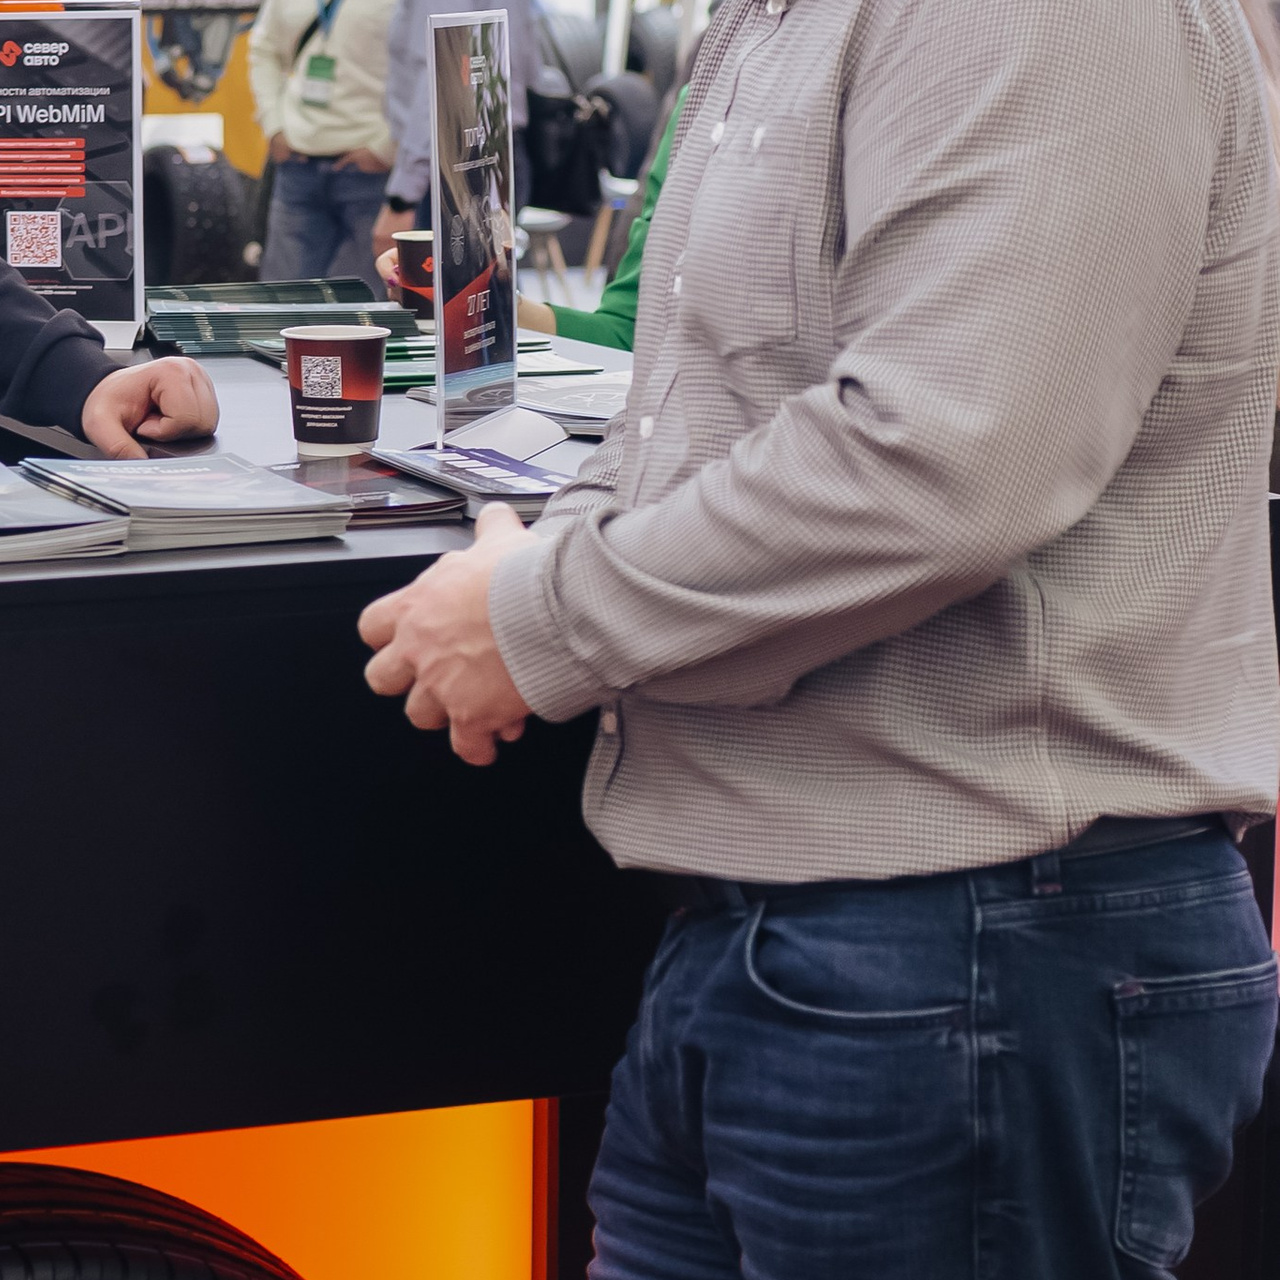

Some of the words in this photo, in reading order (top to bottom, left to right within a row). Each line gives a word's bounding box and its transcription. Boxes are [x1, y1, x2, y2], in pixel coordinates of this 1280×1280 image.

[23, 42, 69, 56] север
[23, 55, 60, 66] авто
[28, 86, 111, 97] автоматизации
[16, 104, 105, 124] WebMiM
